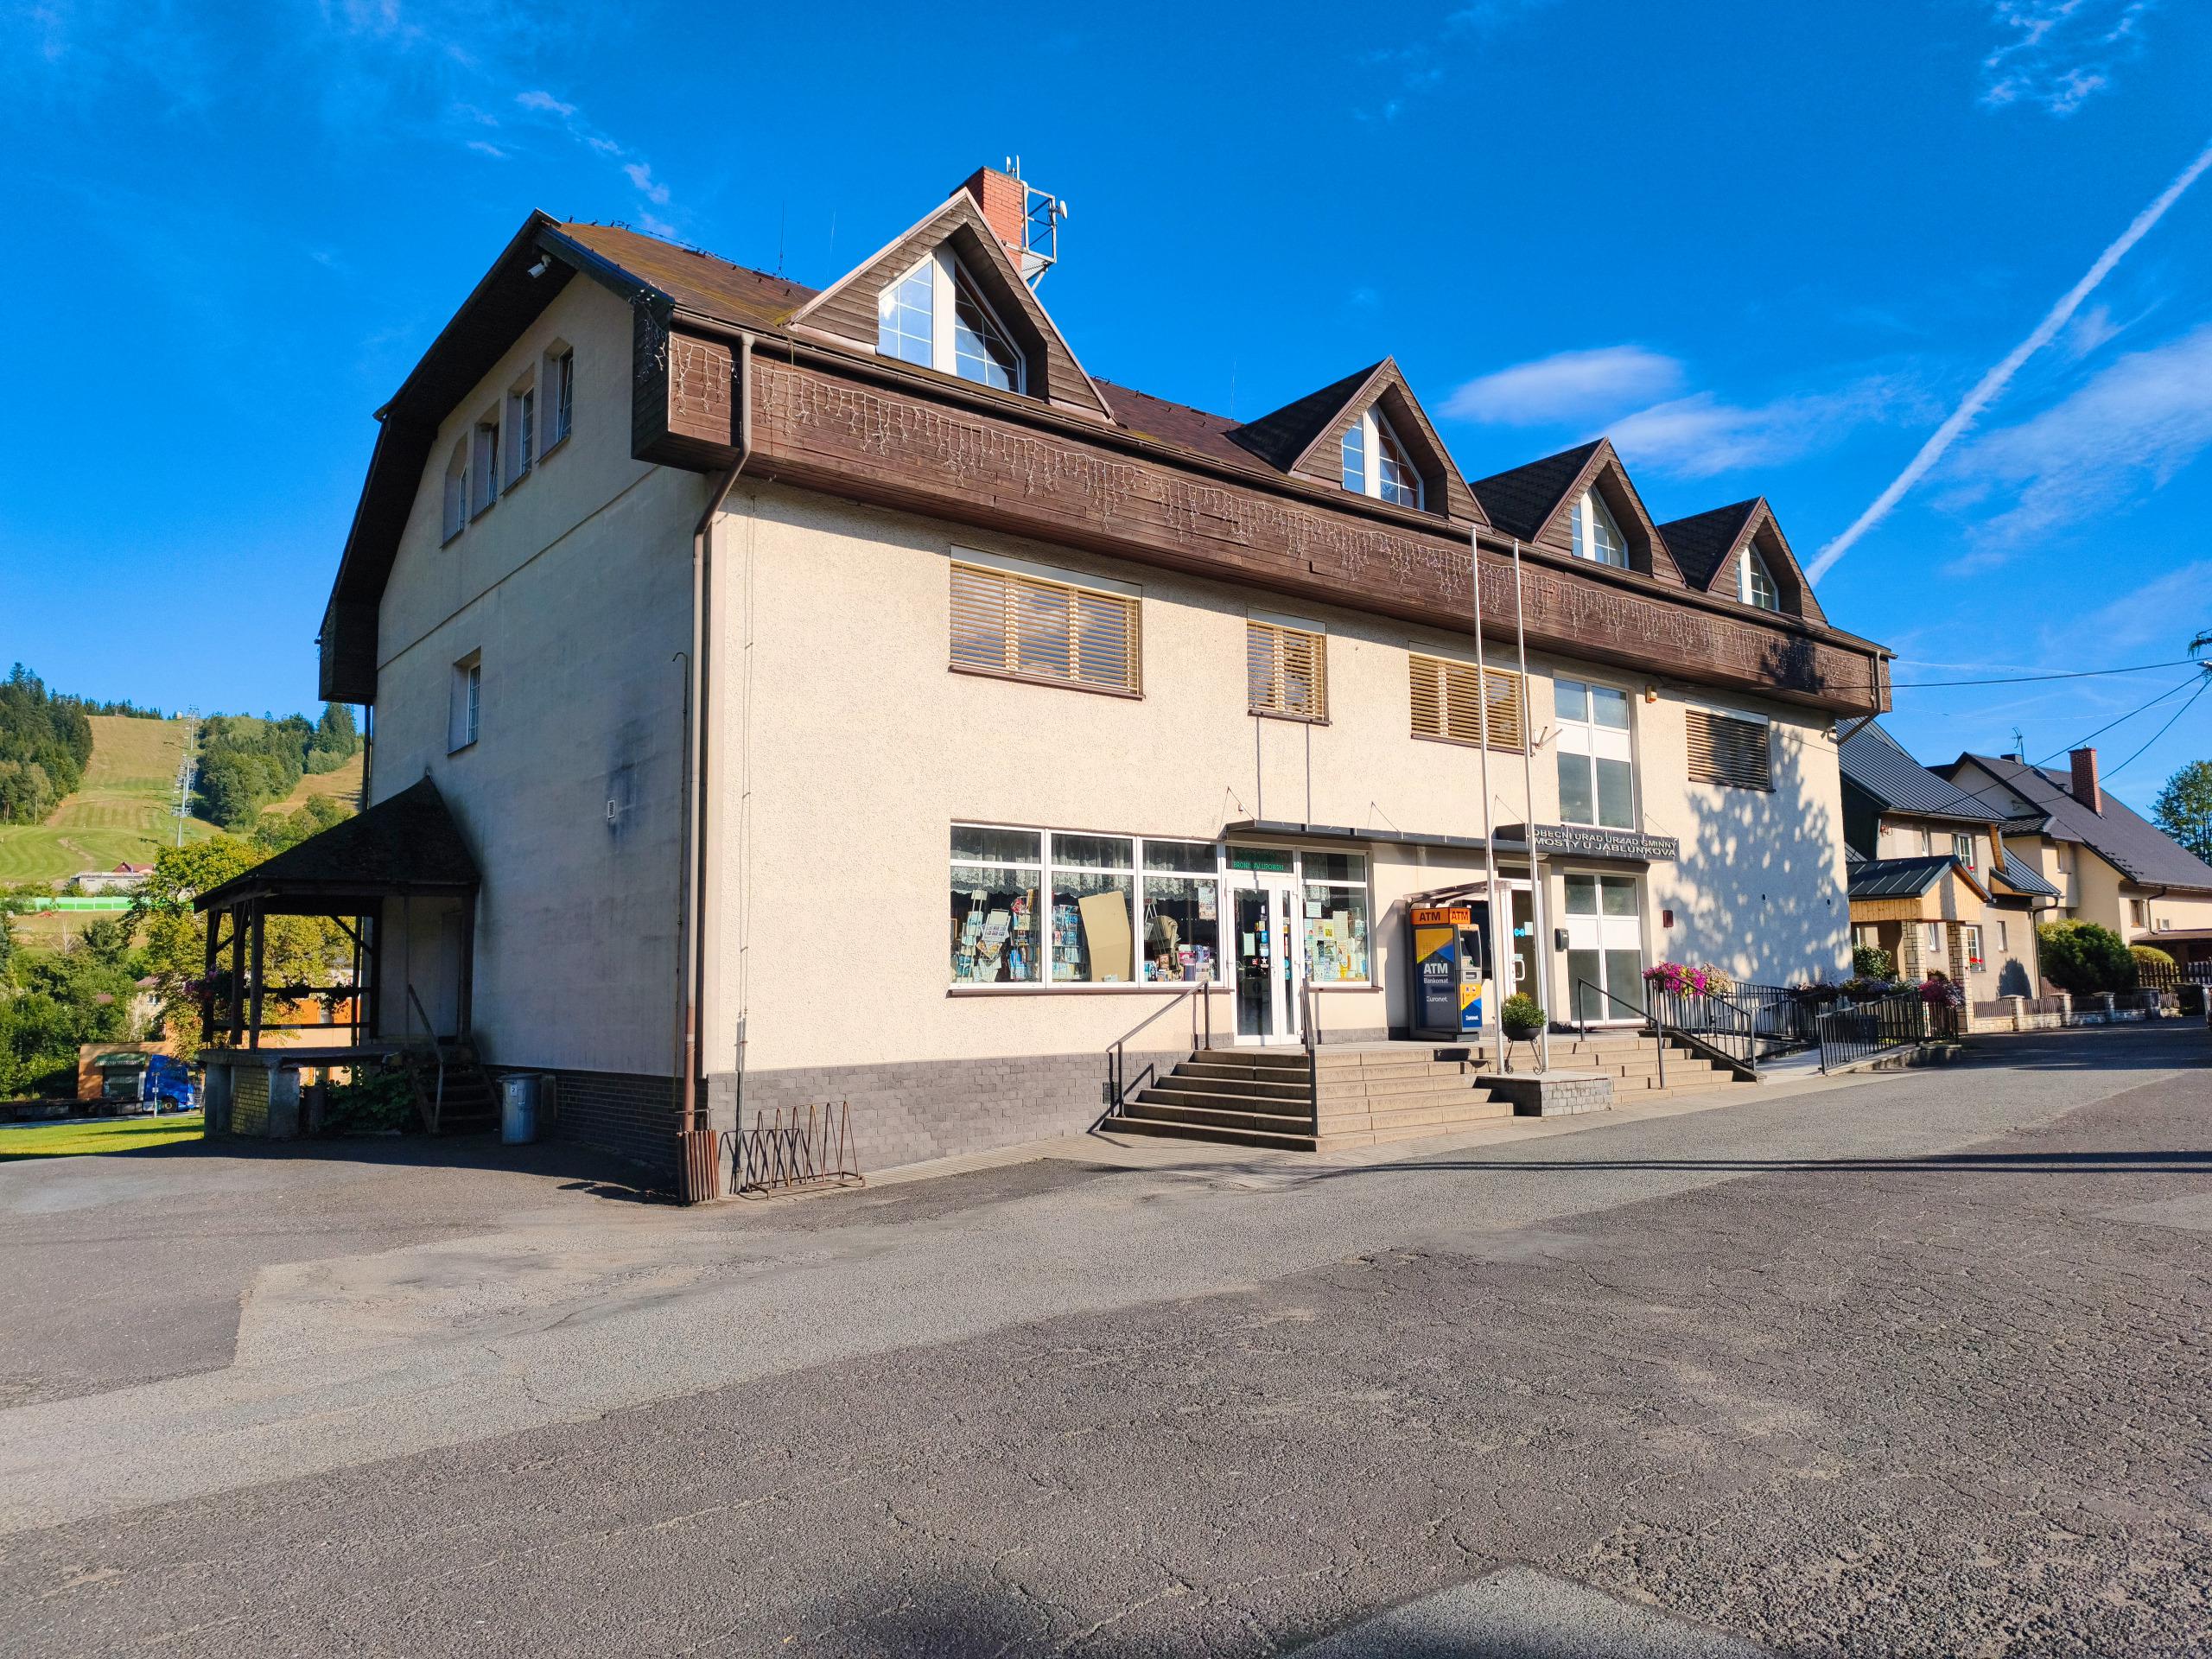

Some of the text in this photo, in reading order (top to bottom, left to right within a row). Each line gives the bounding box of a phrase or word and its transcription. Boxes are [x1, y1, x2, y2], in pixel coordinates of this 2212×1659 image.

[1535, 837, 1676, 857] MOSTY U JABLUNKOVA
[1641, 839, 1677, 849] GMINNY
[1419, 912, 1441, 922] ATM
[1452, 911, 1469, 921] ATM
[1423, 963, 1448, 975] ATM
